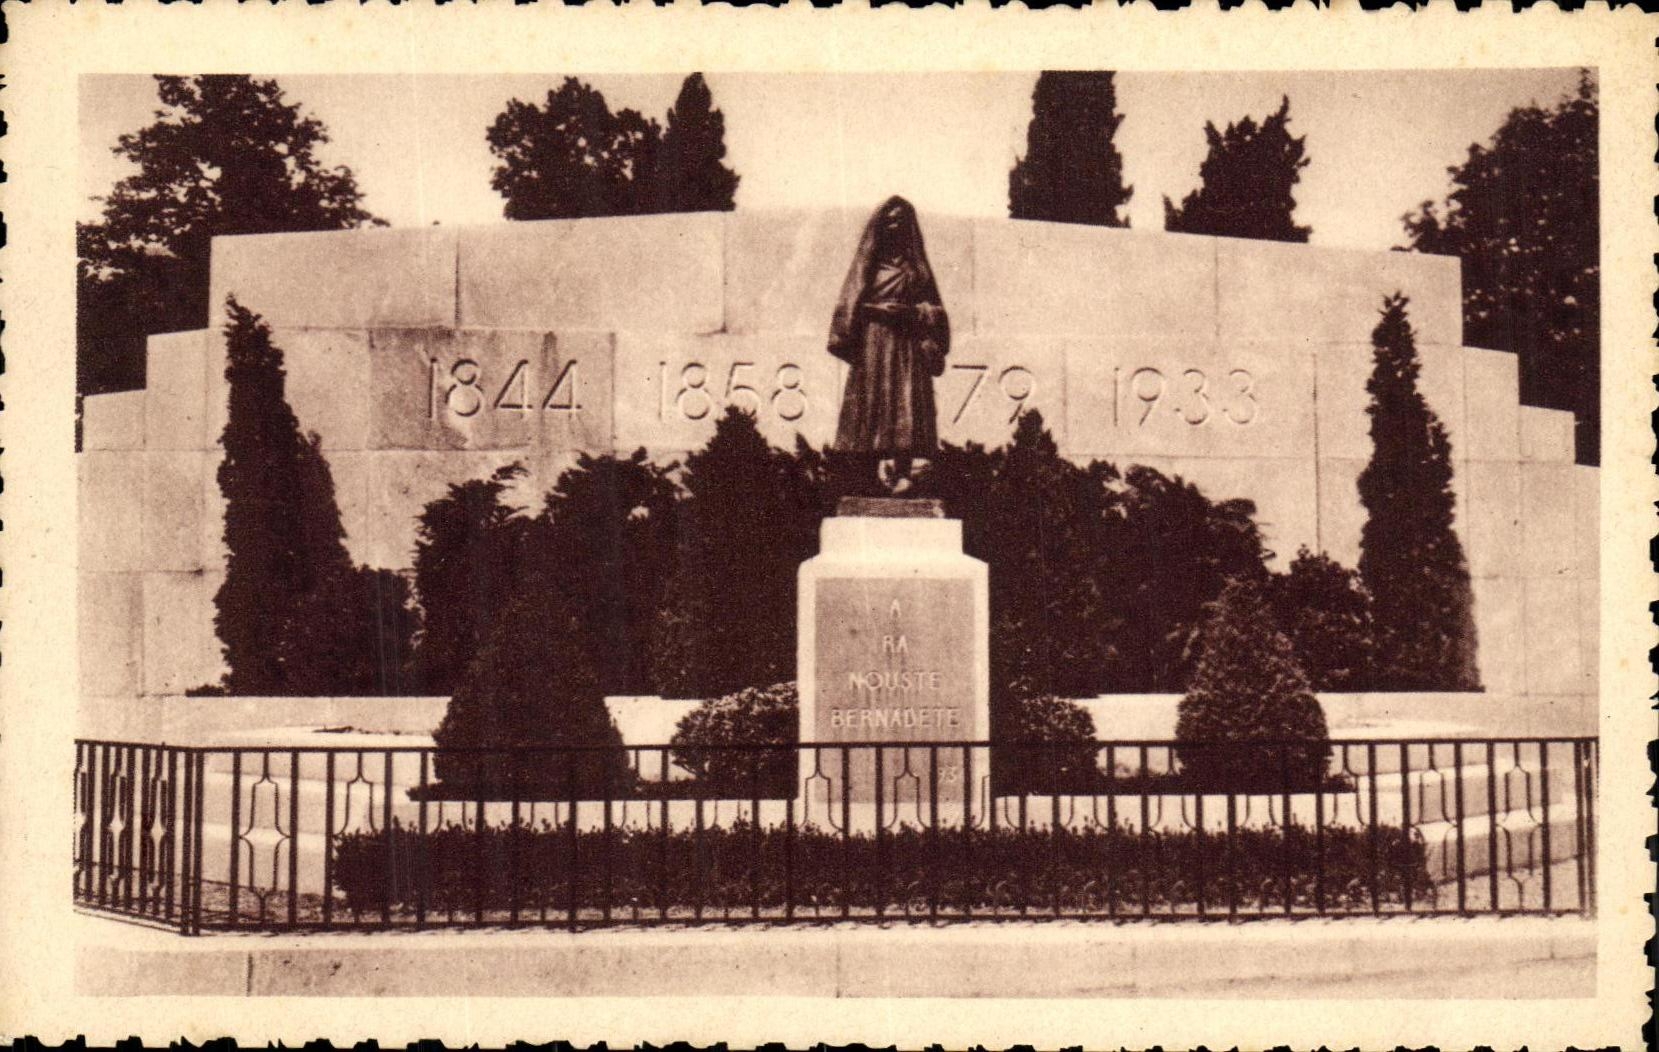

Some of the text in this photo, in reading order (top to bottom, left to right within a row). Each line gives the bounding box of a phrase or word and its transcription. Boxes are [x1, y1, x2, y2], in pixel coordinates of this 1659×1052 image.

[428, 356, 582, 422] 1844
[658, 360, 808, 421] 1858
[952, 364, 1035, 425] 79
[1113, 365, 1258, 426] 1933
[890, 599, 902, 619] A
[882, 634, 908, 654] RA
[849, 671, 943, 690] NOUSTE
[830, 706, 961, 729] BERNADETE
